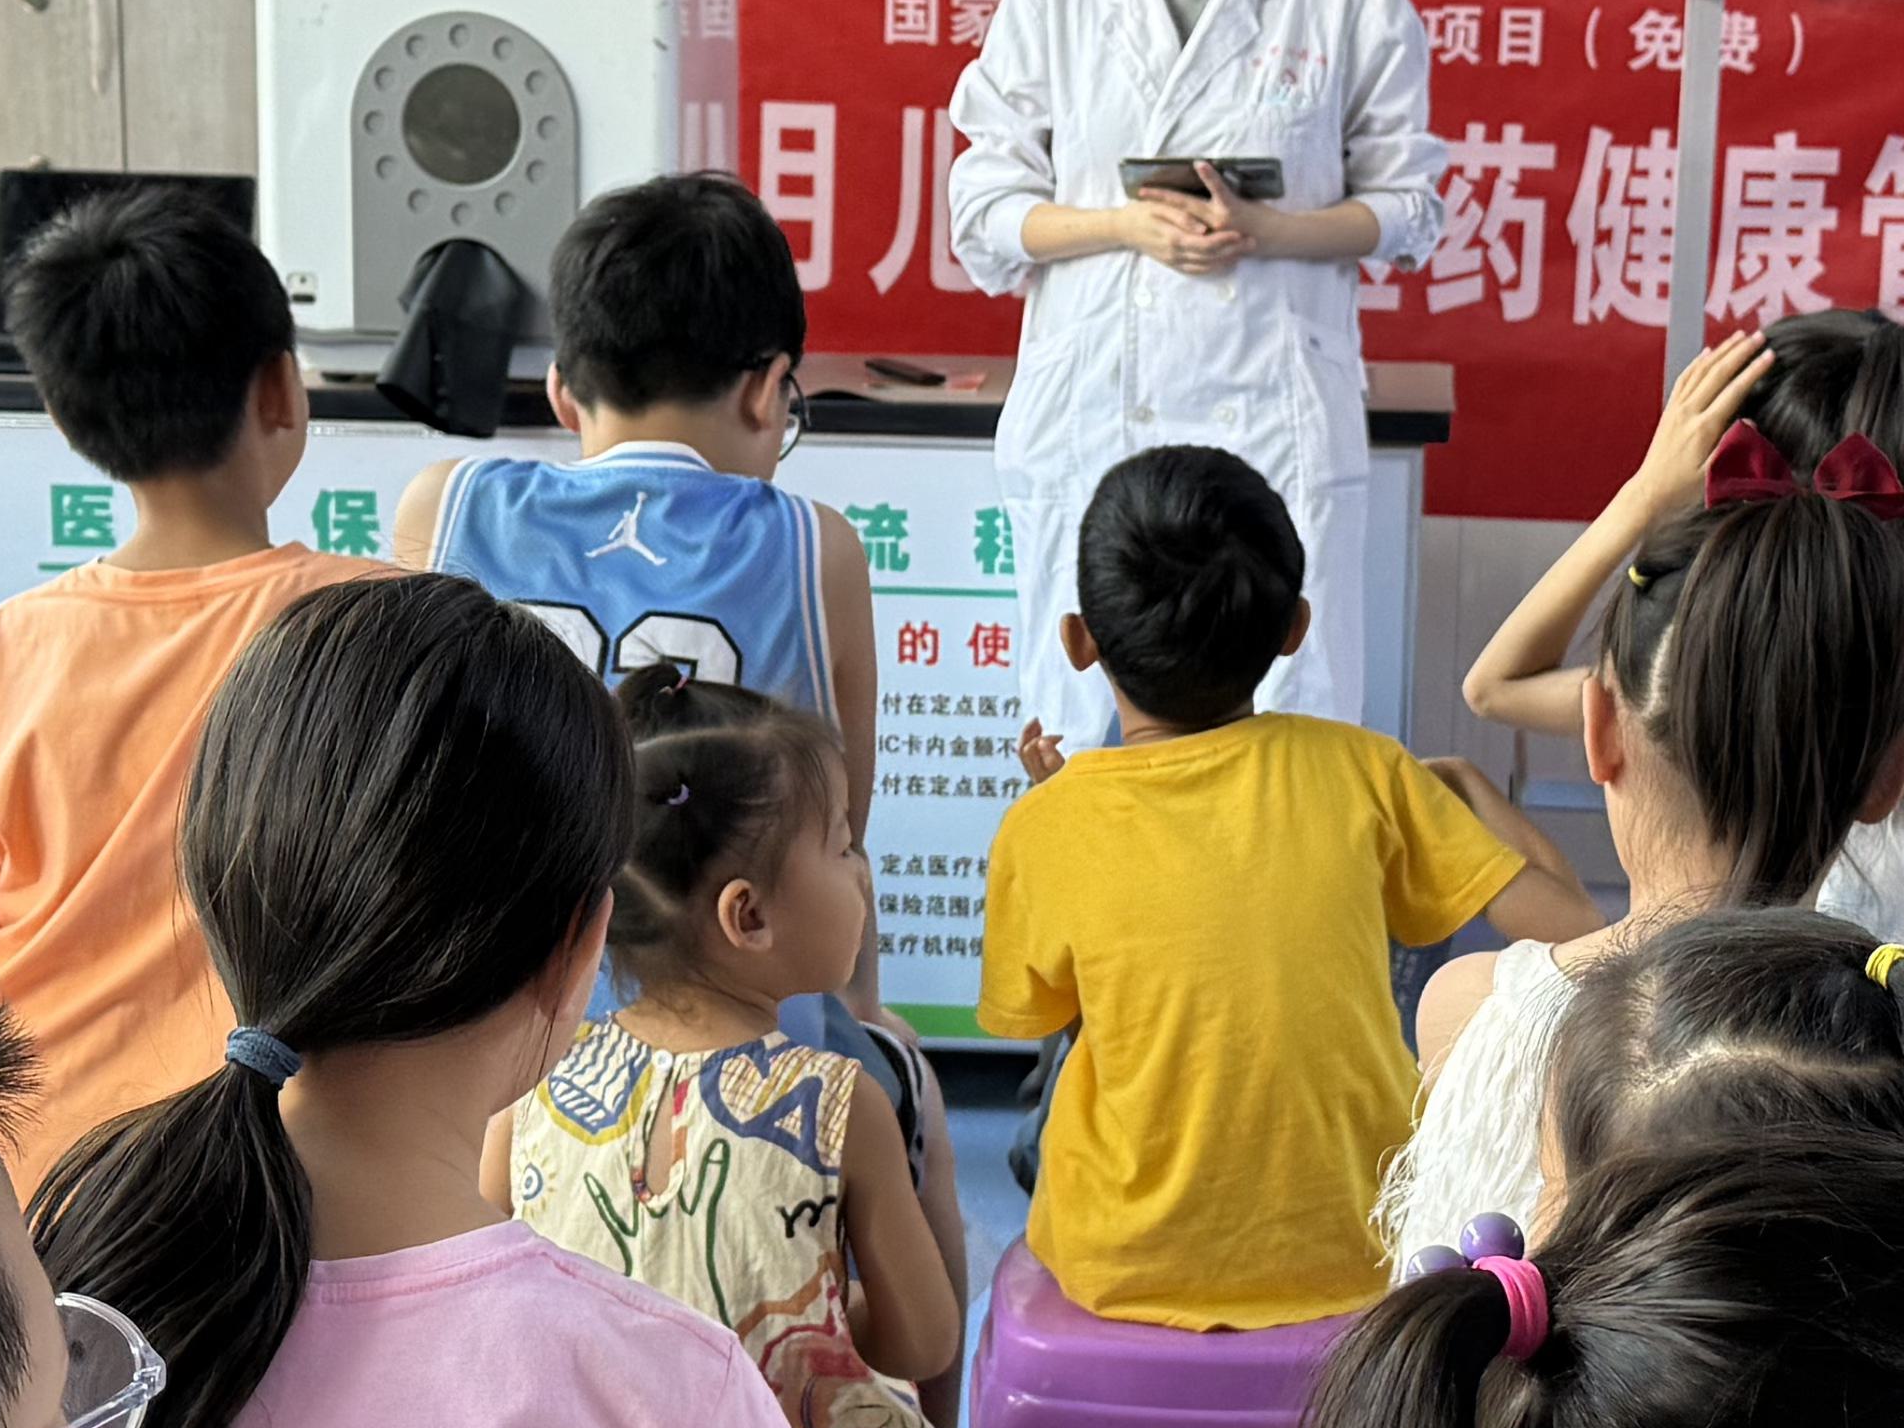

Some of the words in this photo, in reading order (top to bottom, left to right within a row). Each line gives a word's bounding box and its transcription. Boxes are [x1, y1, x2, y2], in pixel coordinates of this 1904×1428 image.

[50, 482, 116, 549] 医
[309, 487, 380, 557] 保
[897, 620, 1011, 668] 的使
[873, 773, 1034, 799] 付在定点医疗
